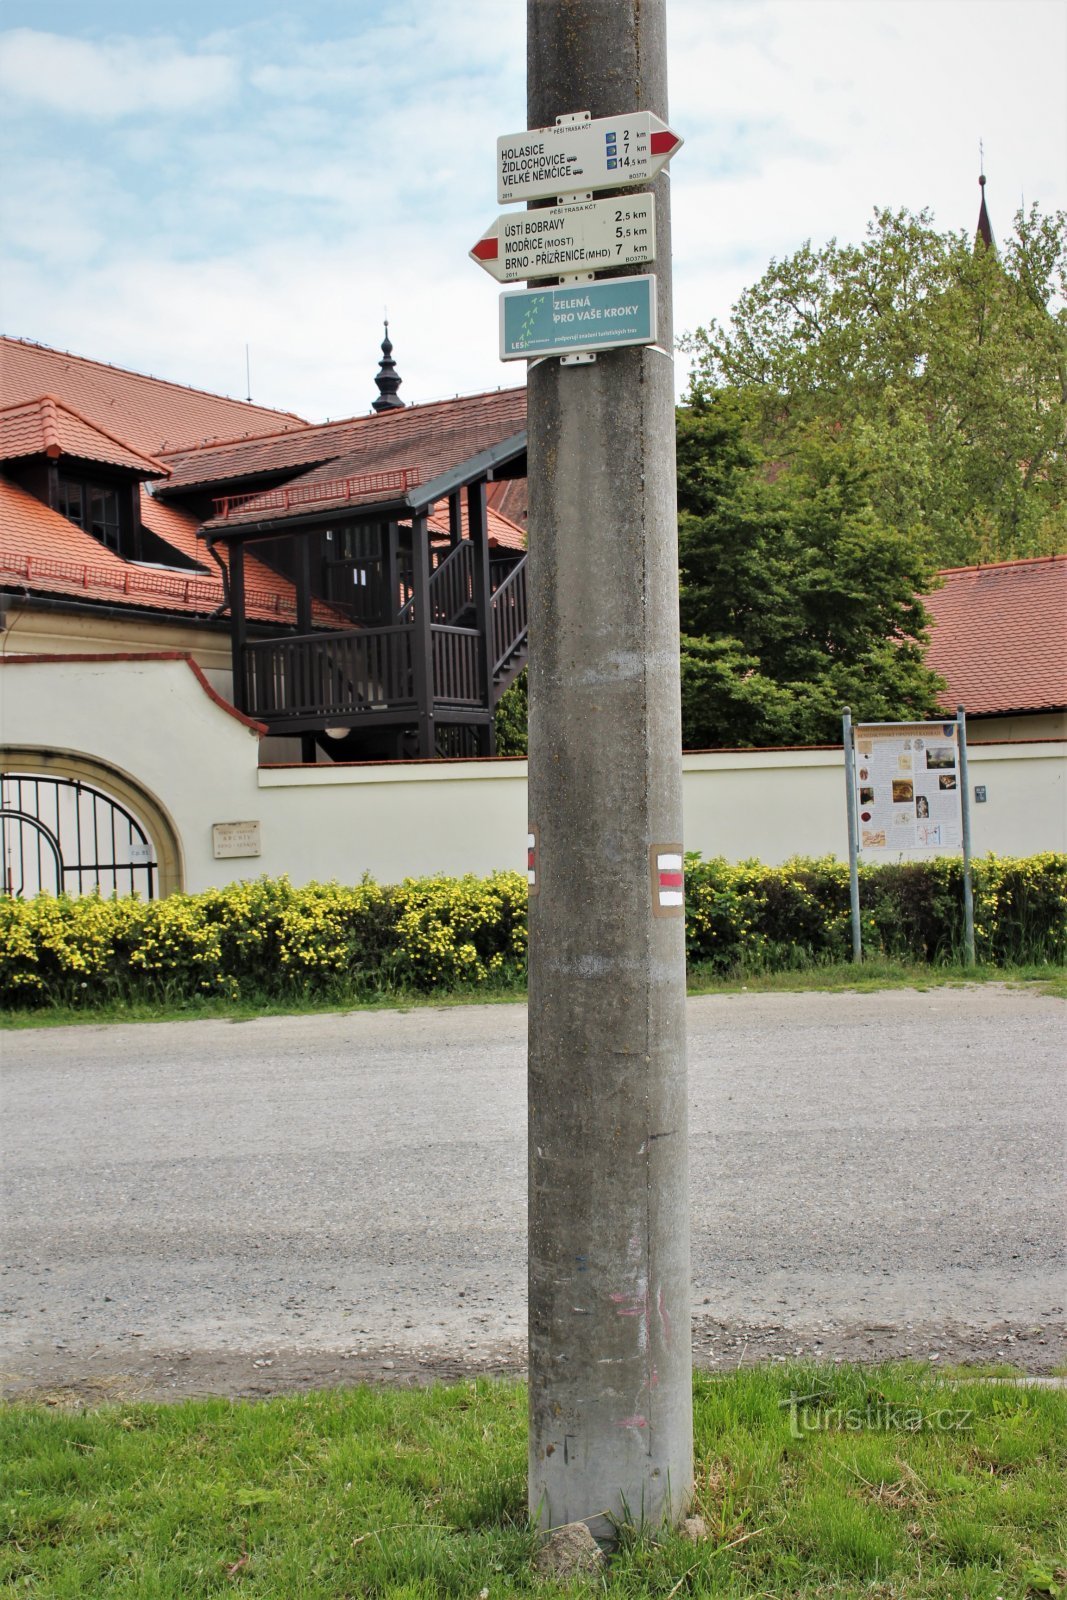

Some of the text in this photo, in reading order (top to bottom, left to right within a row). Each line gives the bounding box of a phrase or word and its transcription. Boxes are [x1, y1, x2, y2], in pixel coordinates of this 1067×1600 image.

[501, 144, 544, 160] HOLASICE
[624, 130, 630, 140] 2
[502, 154, 566, 173] ŽIDLOCHOVICE
[624, 144, 630, 154] 7
[502, 170, 530, 186] VELKÉ
[532, 165, 572, 181] NĚMČICE
[619, 157, 636, 168] 14,5
[504, 222, 523, 237] ÚSTÍ
[525, 218, 564, 234] BOBRAVY
[614, 210, 630, 222] 2,5
[505, 236, 542, 253] MODŘICE
[544, 236, 574, 248] (MOST)
[615, 227, 630, 238] 5,5
[505, 258, 529, 270] BRNO
[536, 248, 584, 266] PŘÍZŘENICE
[586, 250, 611, 260] (MHD)
[616, 244, 622, 255] 7
[554, 296, 590, 310] ZELENÁ
[554, 305, 638, 324] PRO VAŠE KROKY
